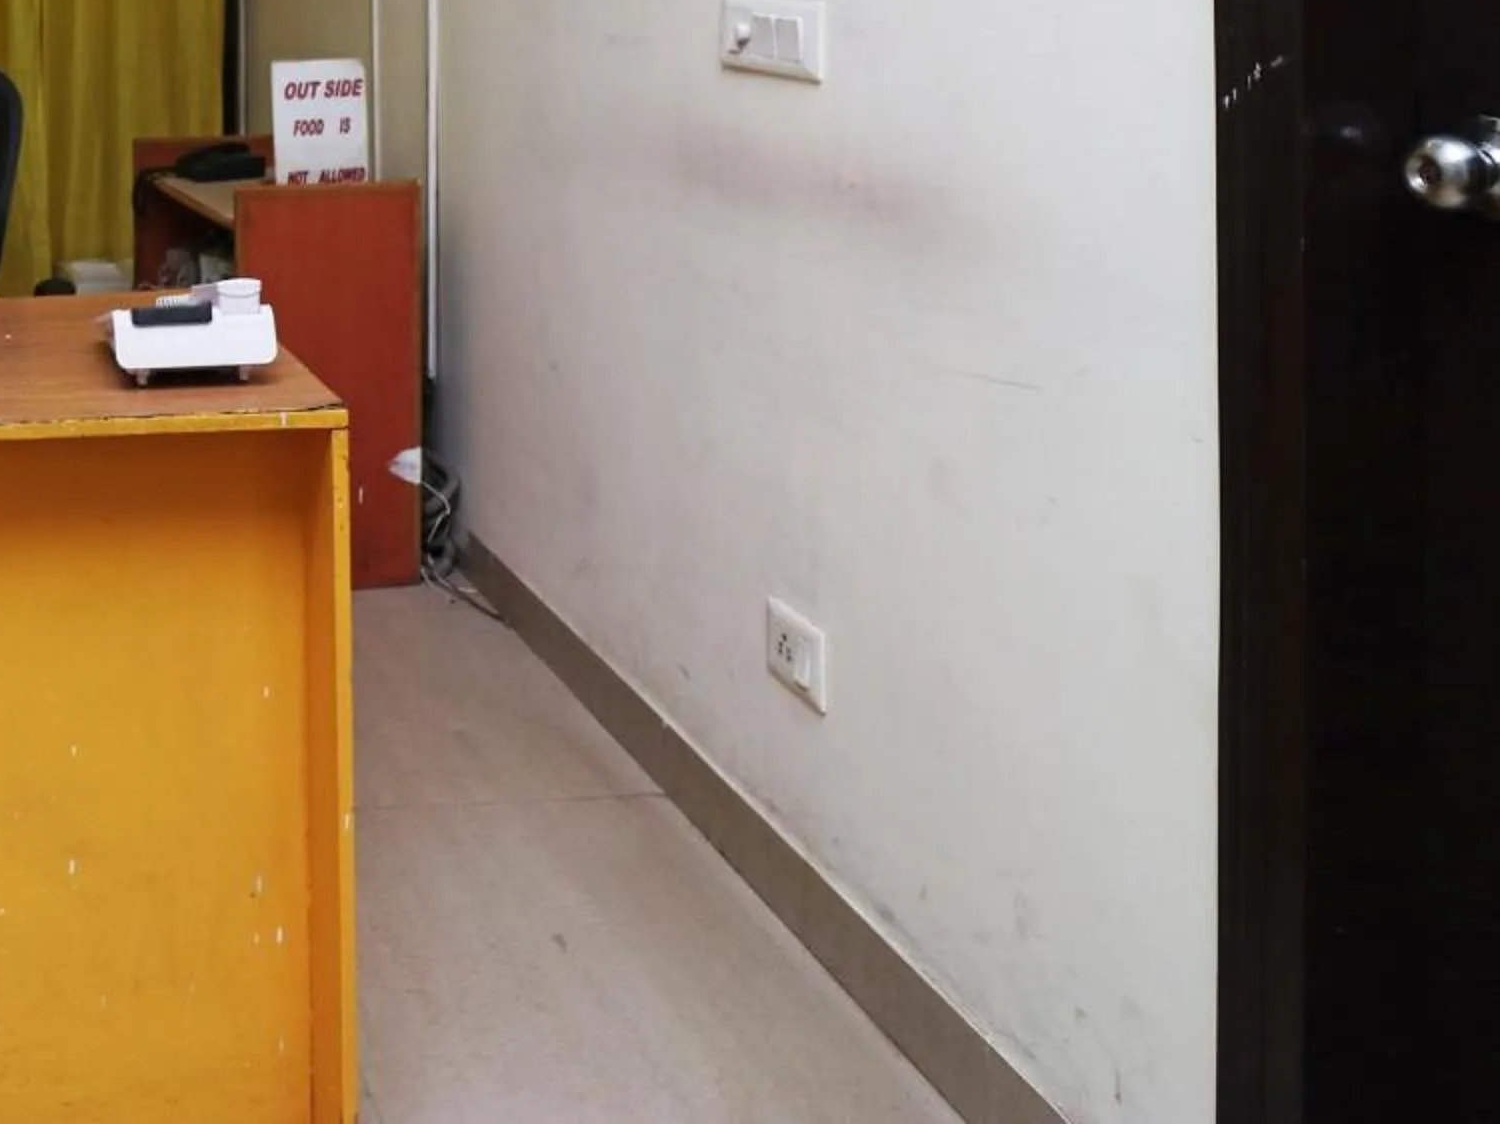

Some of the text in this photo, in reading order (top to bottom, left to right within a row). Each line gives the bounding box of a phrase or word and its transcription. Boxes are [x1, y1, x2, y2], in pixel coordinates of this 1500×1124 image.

[284, 78, 363, 100] OUT SIDE
[293, 116, 351, 136] FOOD IS
